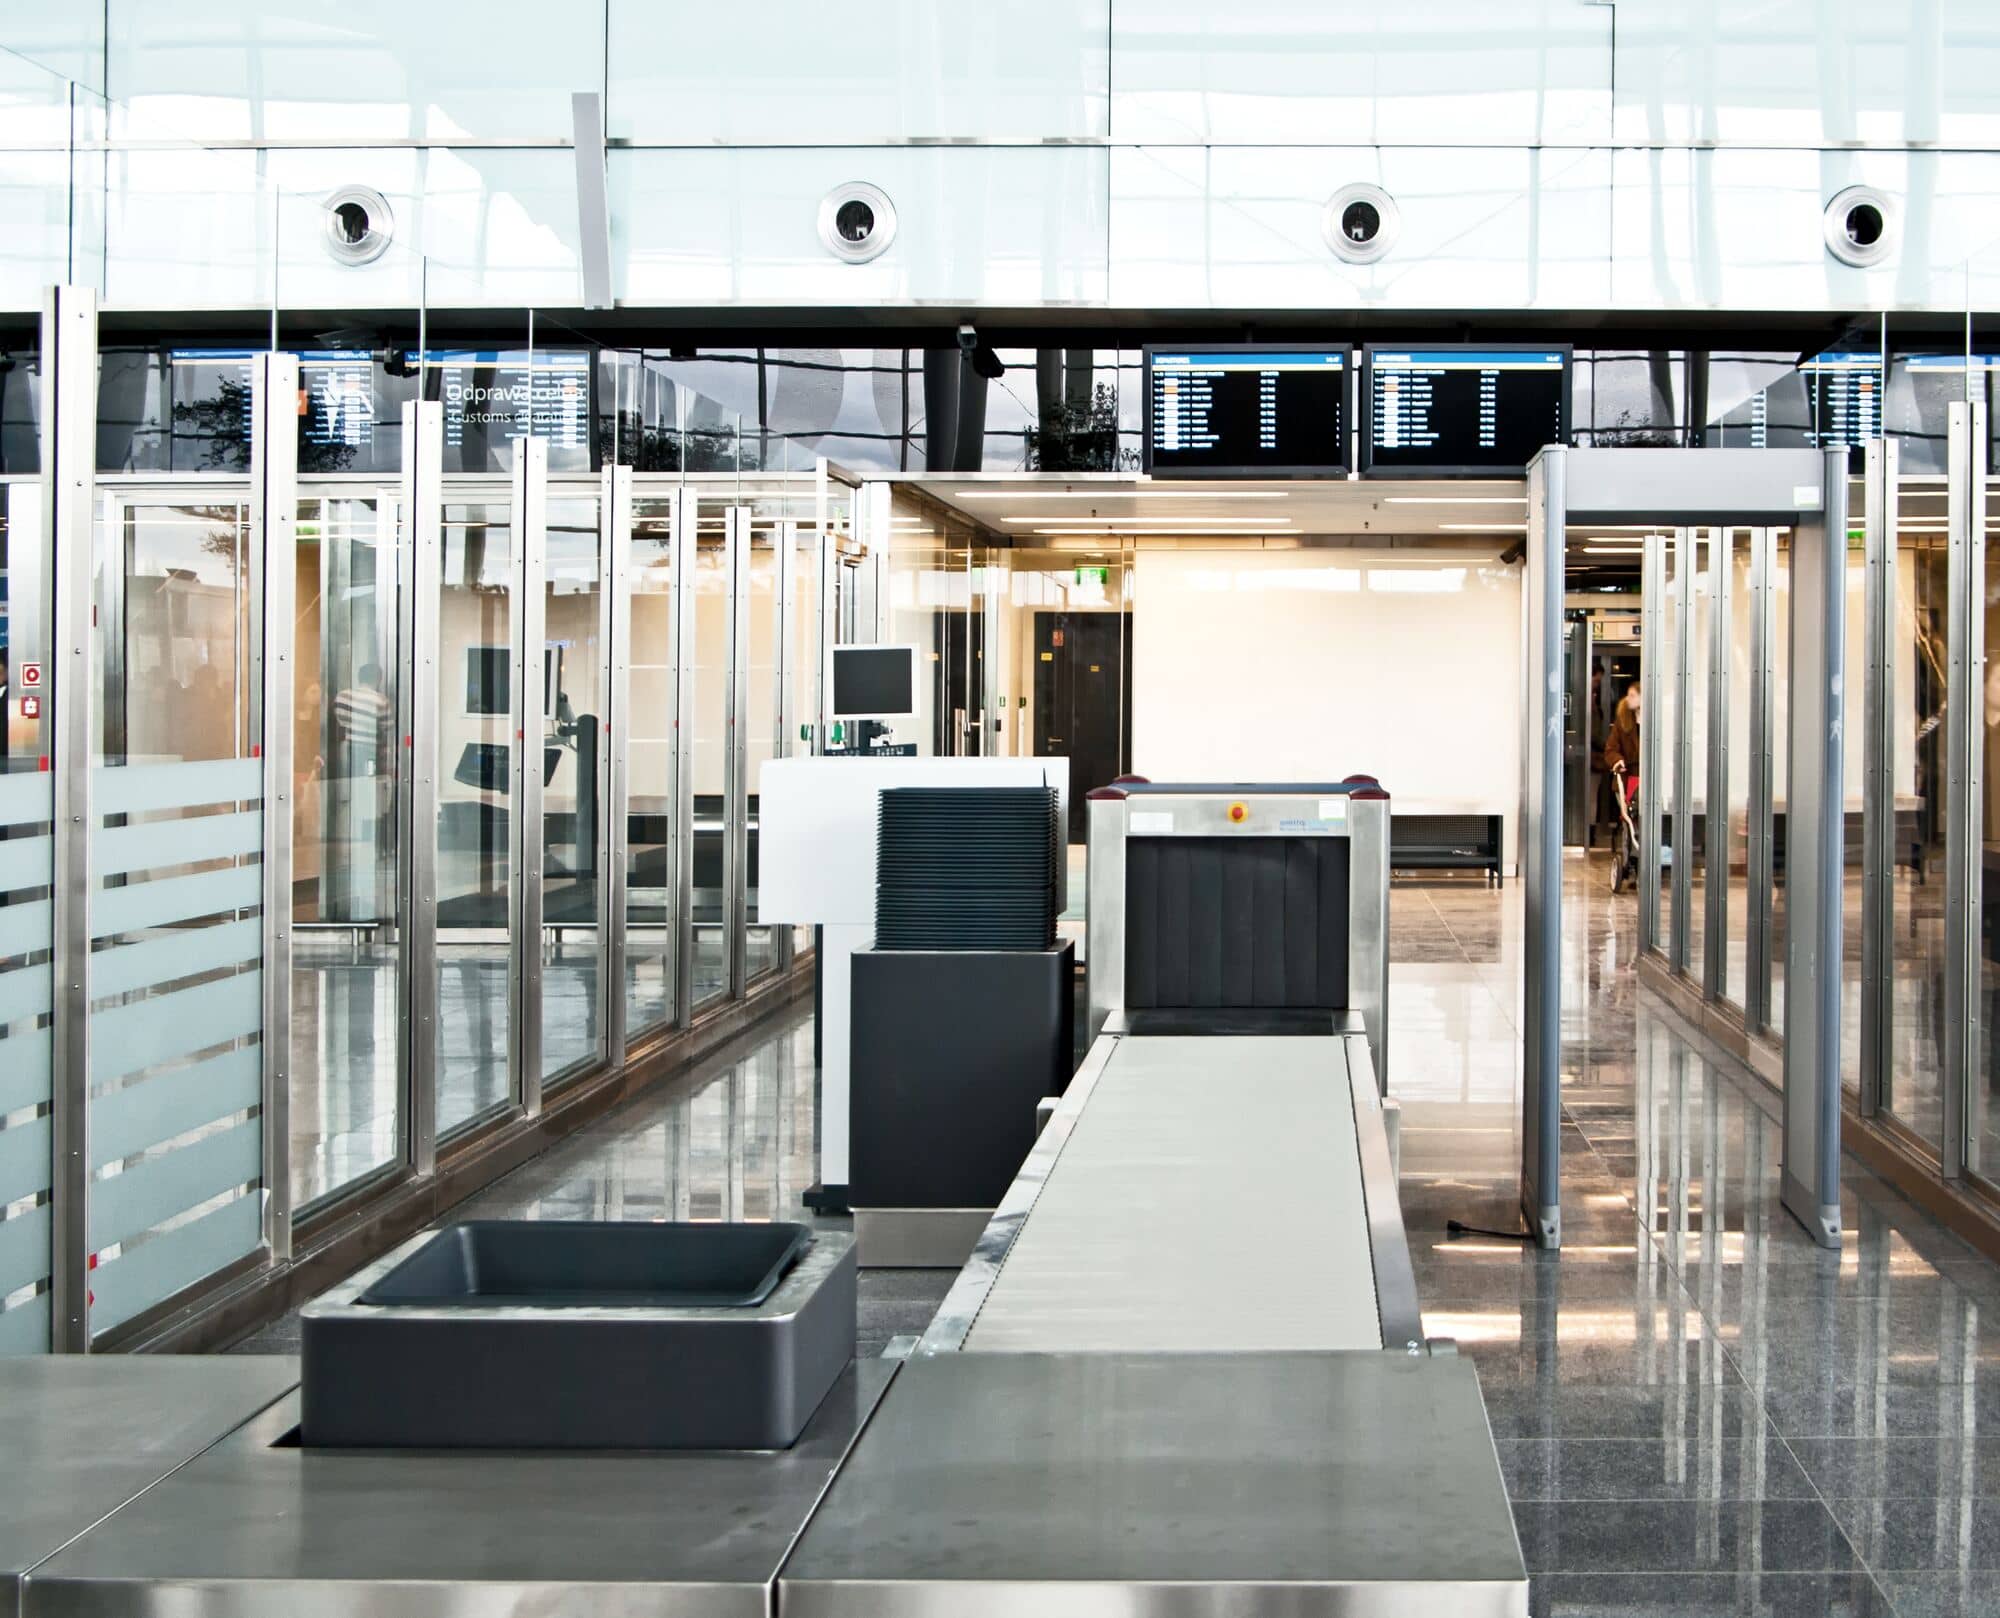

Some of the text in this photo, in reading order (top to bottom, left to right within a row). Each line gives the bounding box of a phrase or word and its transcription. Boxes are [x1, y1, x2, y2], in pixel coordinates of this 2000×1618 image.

[446, 381, 583, 405] Odprawa cela
[452, 410, 511, 424] Customs
